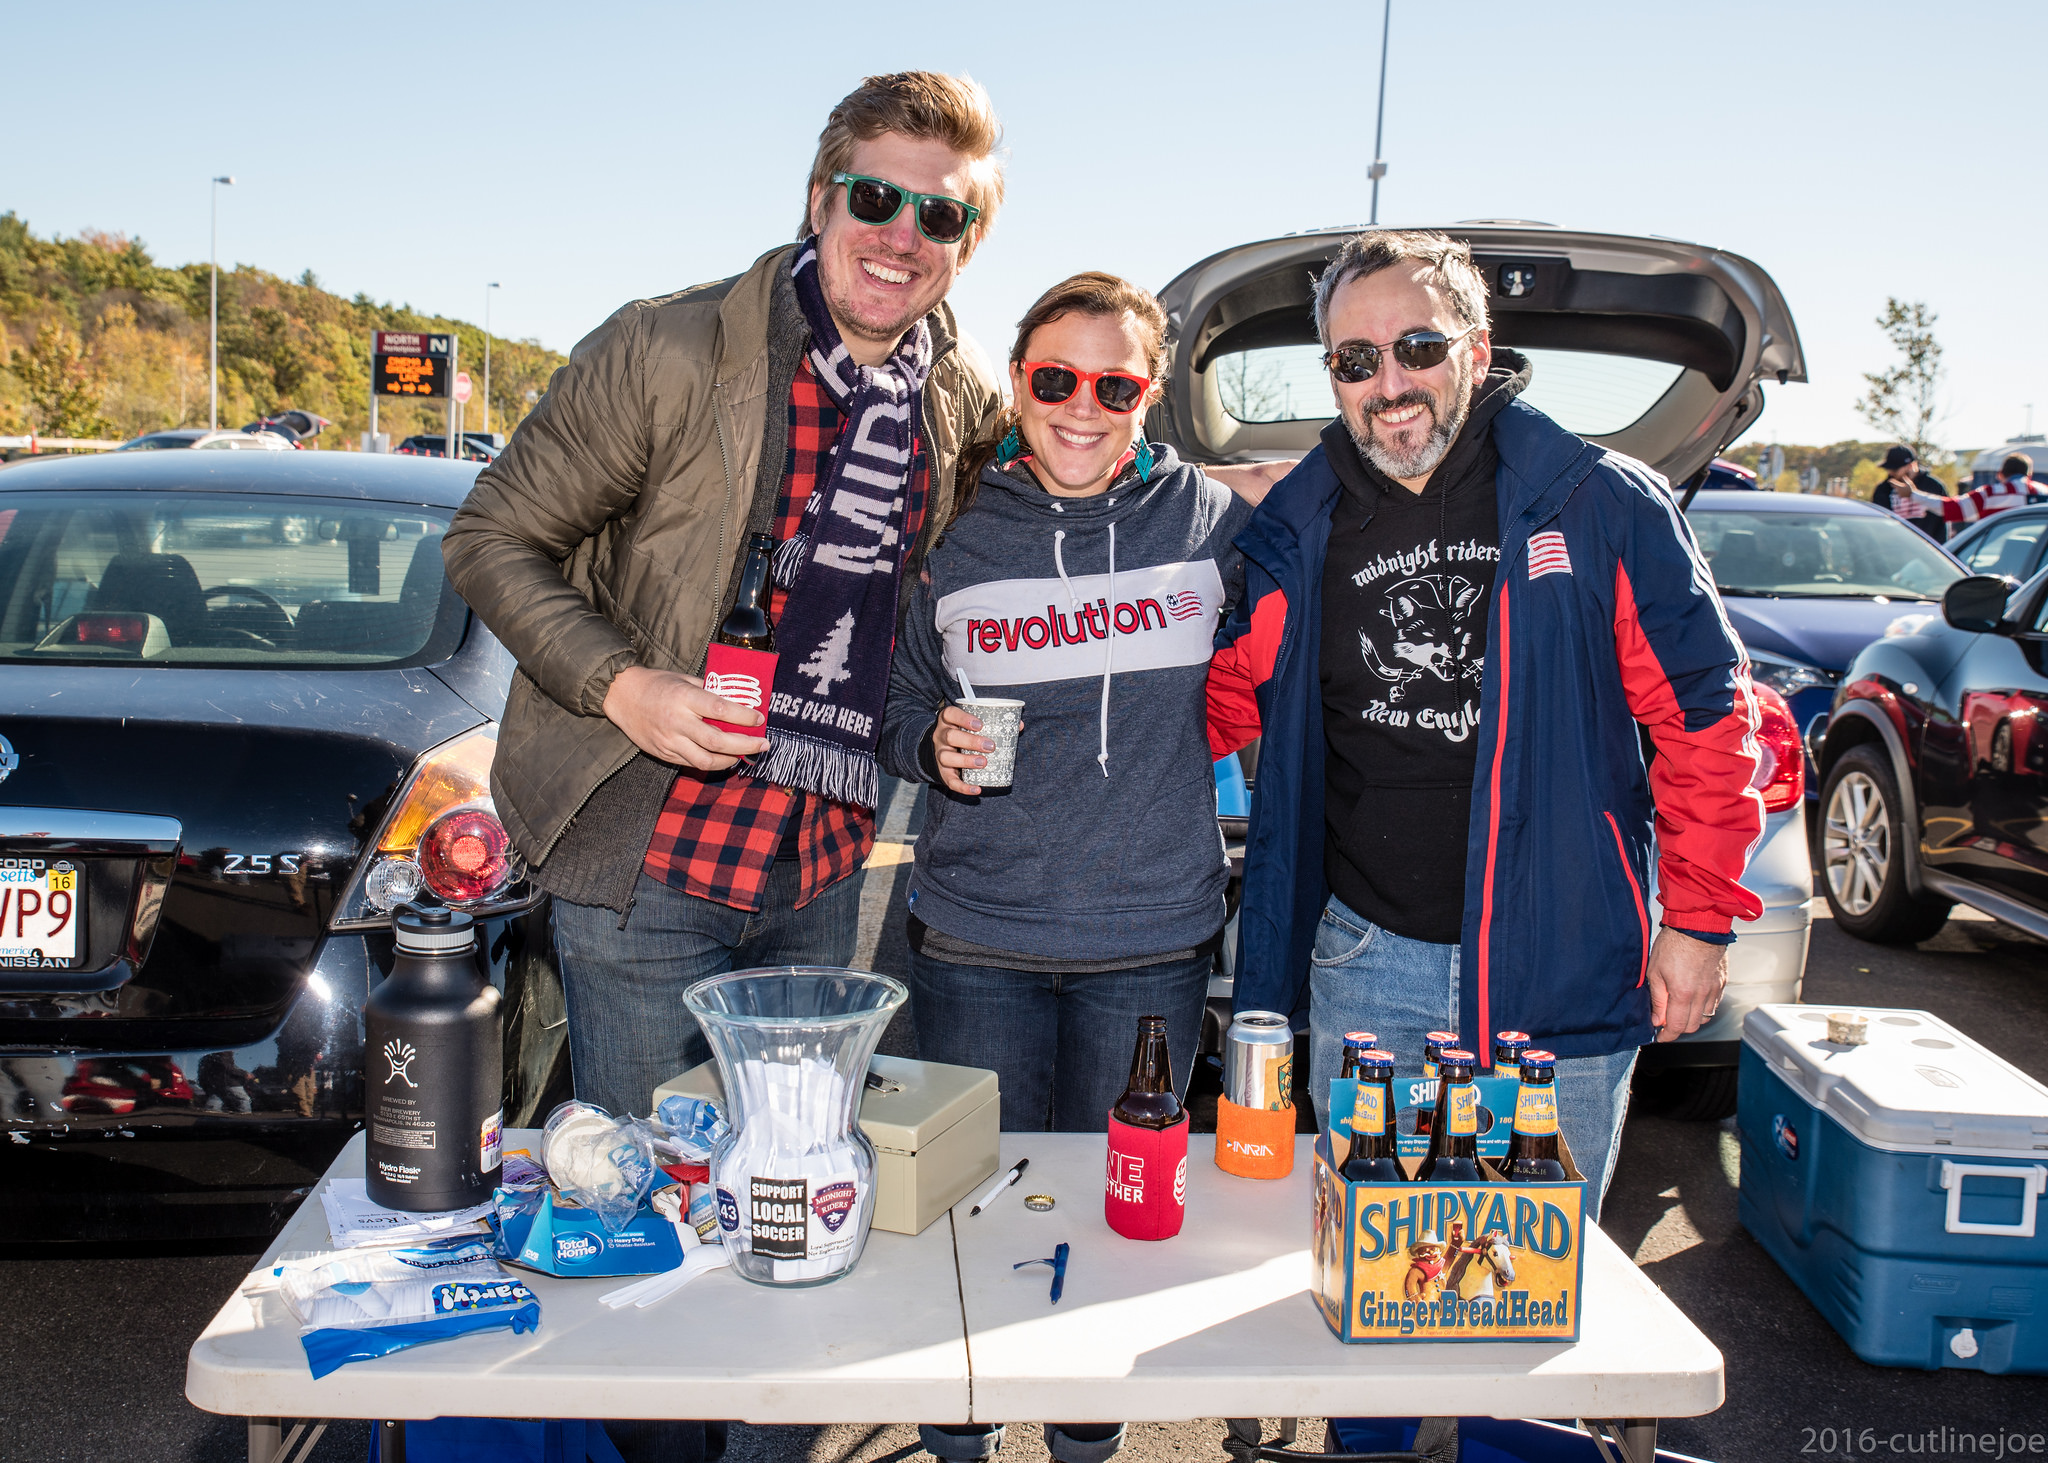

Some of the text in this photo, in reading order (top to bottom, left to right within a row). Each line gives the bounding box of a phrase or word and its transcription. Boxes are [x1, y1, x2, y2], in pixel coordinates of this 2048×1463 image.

[384, 334, 420, 345] NORTH
[429, 338, 448, 353] N
[1351, 537, 1501, 588] midnight riders
[967, 597, 1168, 653] revolution
[801, 701, 836, 724] OVER
[836, 707, 874, 739] HERE
[1361, 699, 1411, 729] New
[53, 876, 71, 889] 16
[382, 1095, 407, 1105] BREWED
[392, 1108, 421, 1116] BREWERY
[379, 1161, 398, 1173] Hydro
[751, 1182, 805, 1200] SUPPORT
[815, 1190, 853, 1205] MIDNIGHT
[752, 1201, 805, 1224] LOCAL
[821, 1201, 849, 1214] RIDERS
[697, 1219, 717, 1235] cotch
[752, 1223, 805, 1242] SOCCER
[1360, 1190, 1573, 1261] SHIPYARD
[556, 1237, 589, 1250] Total
[557, 1245, 597, 1259] Home
[1359, 1290, 1569, 1335] GingerBreadHead
